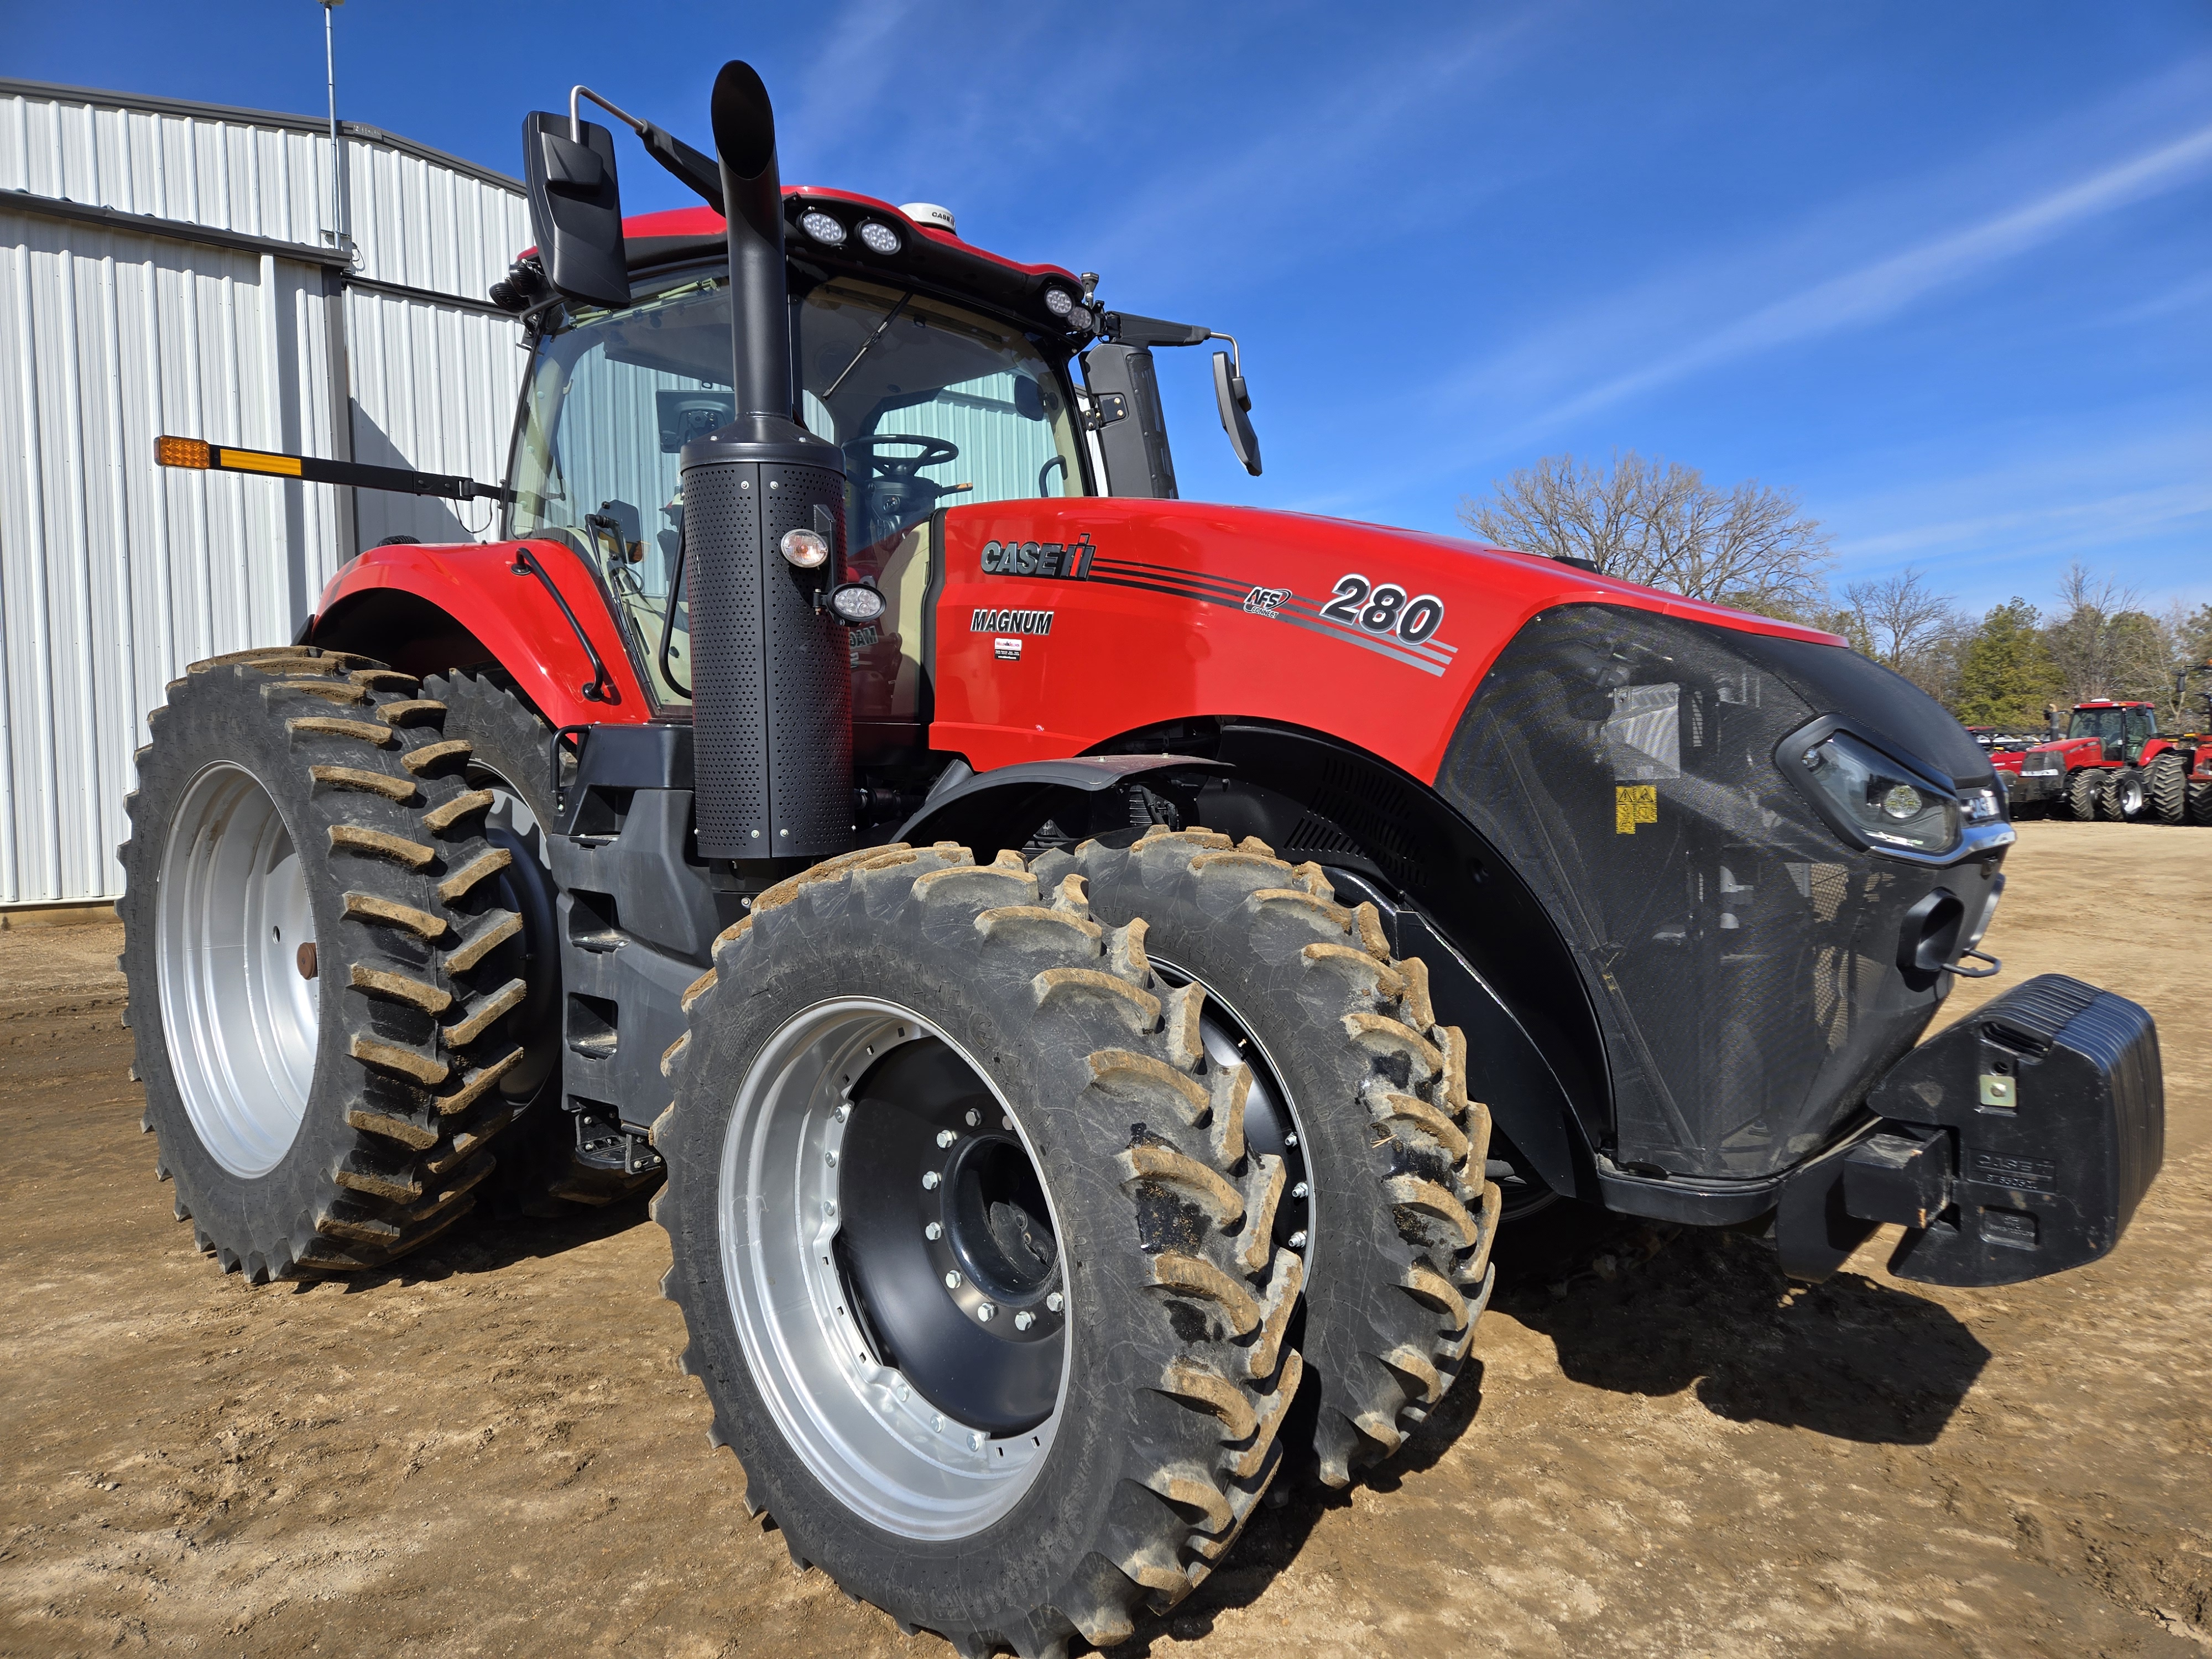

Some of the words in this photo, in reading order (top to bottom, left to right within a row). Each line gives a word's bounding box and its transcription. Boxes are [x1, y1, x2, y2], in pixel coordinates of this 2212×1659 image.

[980, 540, 1063, 578] CASE
[1244, 587, 1282, 608] AFS
[1319, 573, 1444, 646] 280
[971, 609, 1054, 635] MAGNUM
[1251, 606, 1279, 619] CONNECT
